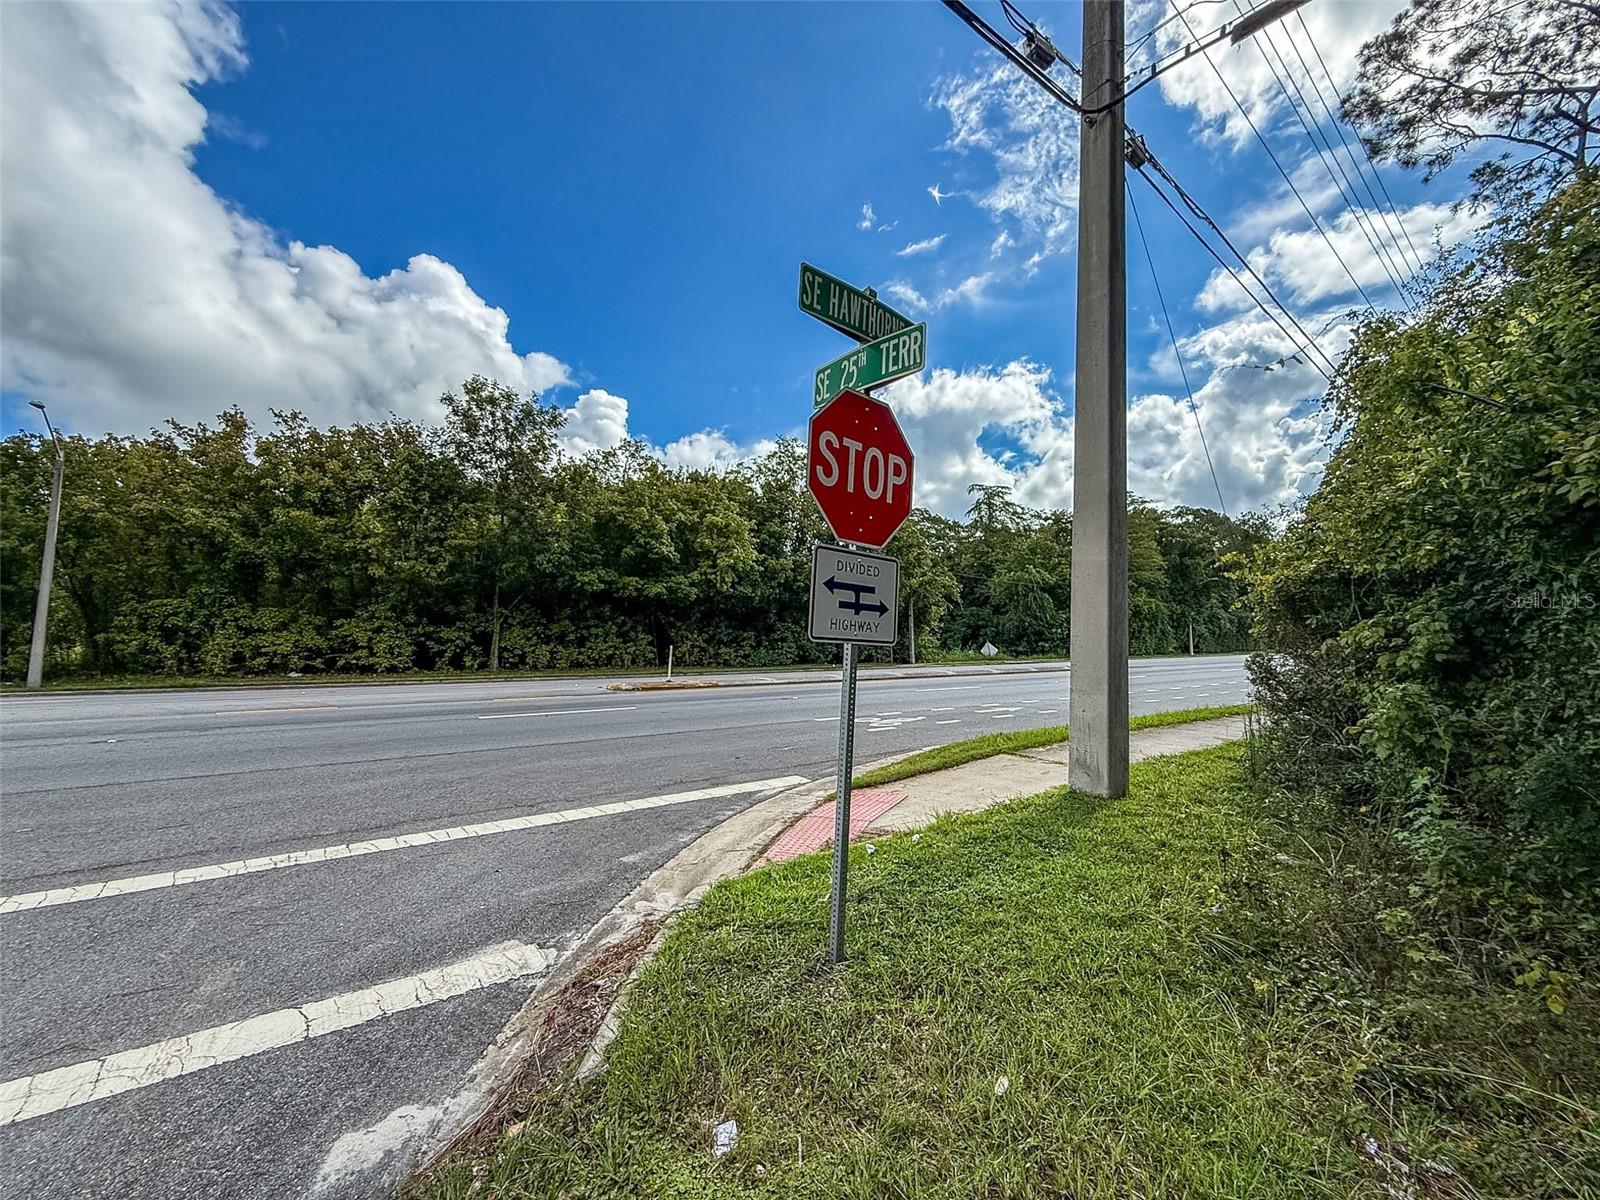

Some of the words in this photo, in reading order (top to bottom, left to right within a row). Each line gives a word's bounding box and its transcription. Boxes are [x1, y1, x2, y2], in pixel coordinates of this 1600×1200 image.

[803, 272, 822, 310] SE
[816, 368, 831, 402] SE
[880, 331, 922, 375] TERR
[815, 430, 907, 504] STOP
[836, 560, 880, 578] DIVIDED
[829, 618, 881, 634] HIGHWAY
